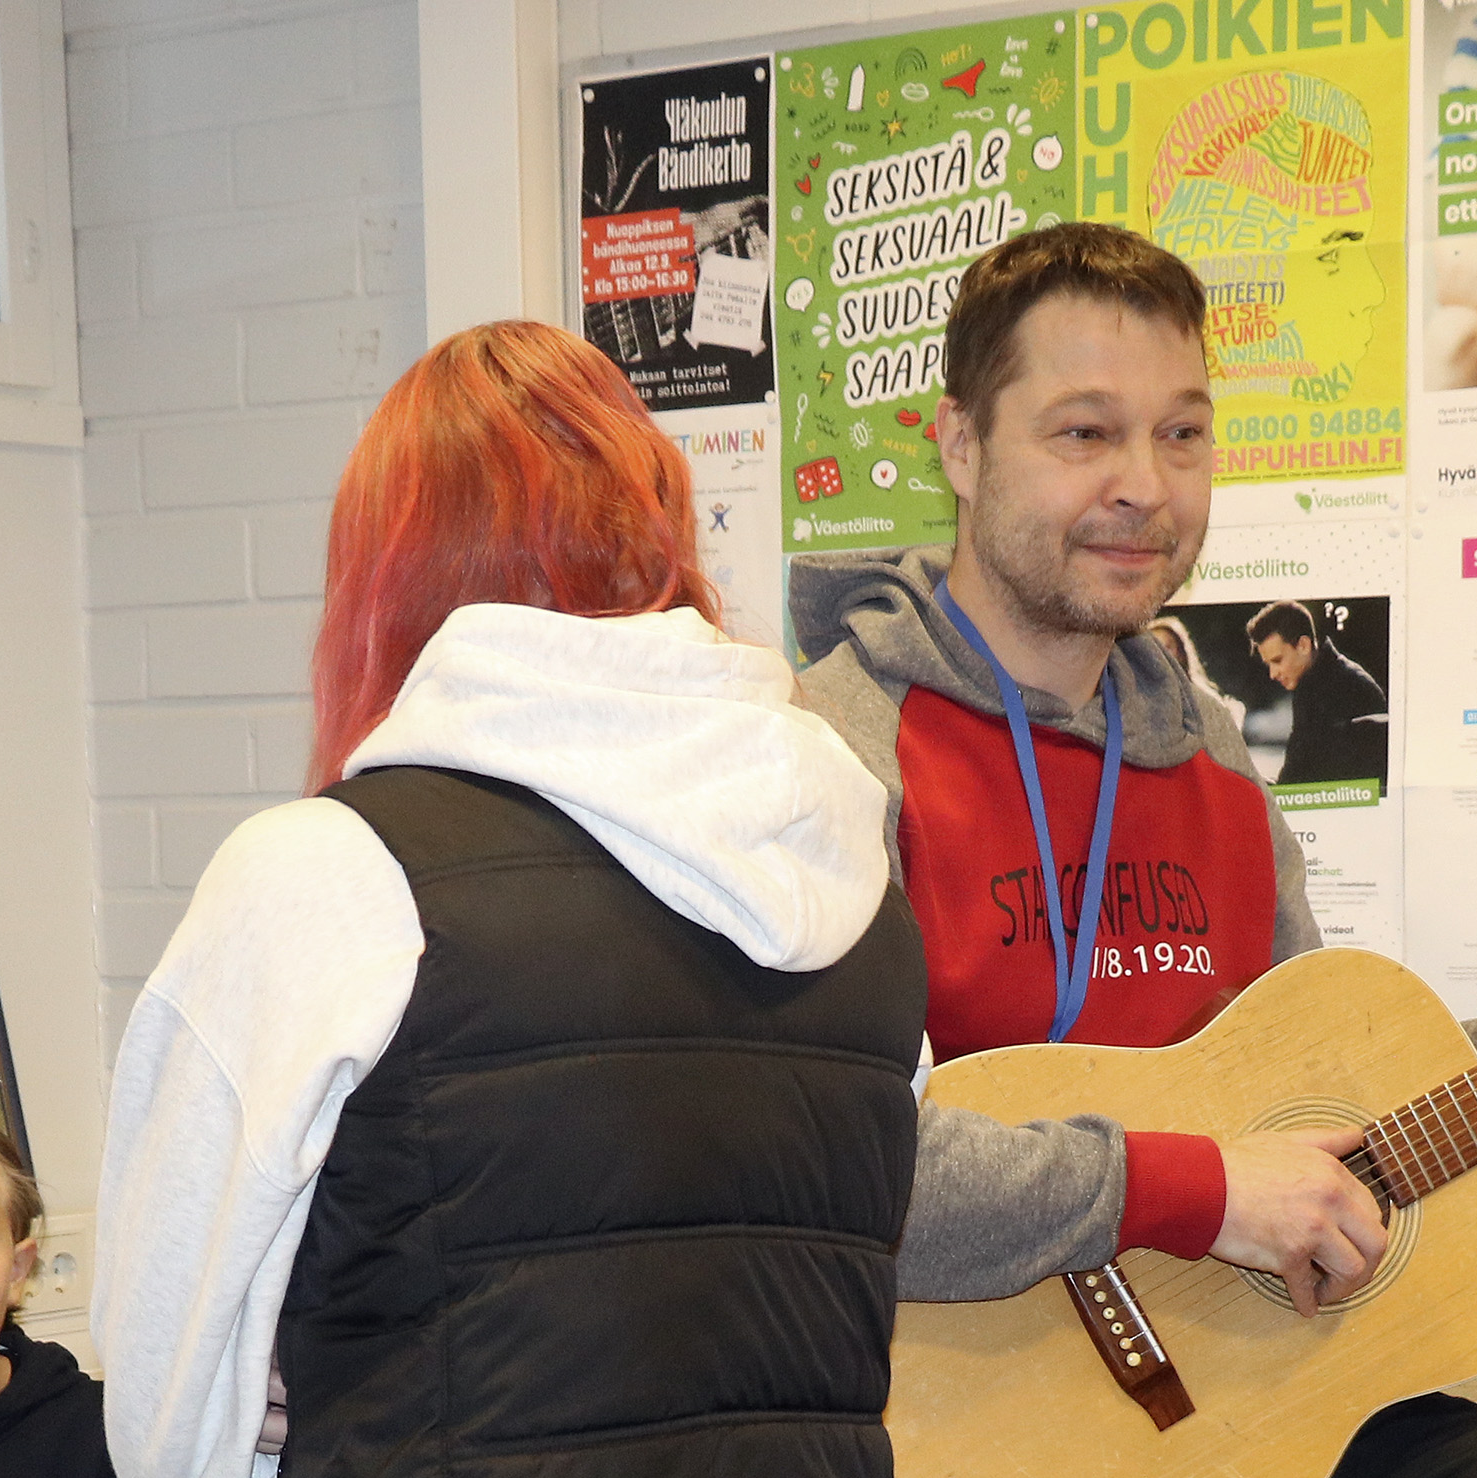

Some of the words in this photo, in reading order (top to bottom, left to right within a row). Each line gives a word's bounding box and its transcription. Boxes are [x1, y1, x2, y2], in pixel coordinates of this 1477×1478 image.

[1083, 0, 1405, 77] POIKIEN
[665, 91, 747, 143] Yläkoulun
[1039, 146, 1055, 160] NO
[1150, 72, 1288, 217] SEKSUAALISUUS
[1297, 120, 1371, 184] TUNTEET
[658, 138, 752, 192] Bändikerho
[830, 139, 968, 217] SEKSISTÄ
[981, 137, 1003, 180] &
[836, 200, 1021, 278] SEKSUAALI-
[1153, 217, 1298, 259] TERVEYS
[610, 258, 643, 274] Alkaa
[595, 279, 614, 295] Klo
[842, 275, 960, 339] SUUDES
[1213, 320, 1278, 346] TUNTO
[679, 428, 765, 455] TUMINEN
[1226, 413, 1299, 443] 0800
[1309, 407, 1402, 438] 94884
[1213, 437, 1403, 473] ENPUHELIN.FI
[1438, 465, 1476, 485] Hyvä
[1315, 491, 1391, 508] Väestöliitt
[813, 516, 895, 536] Väestöliitto
[1197, 559, 1310, 580] Väestöliitto
[1276, 787, 1372, 806] nvaestoliitto
